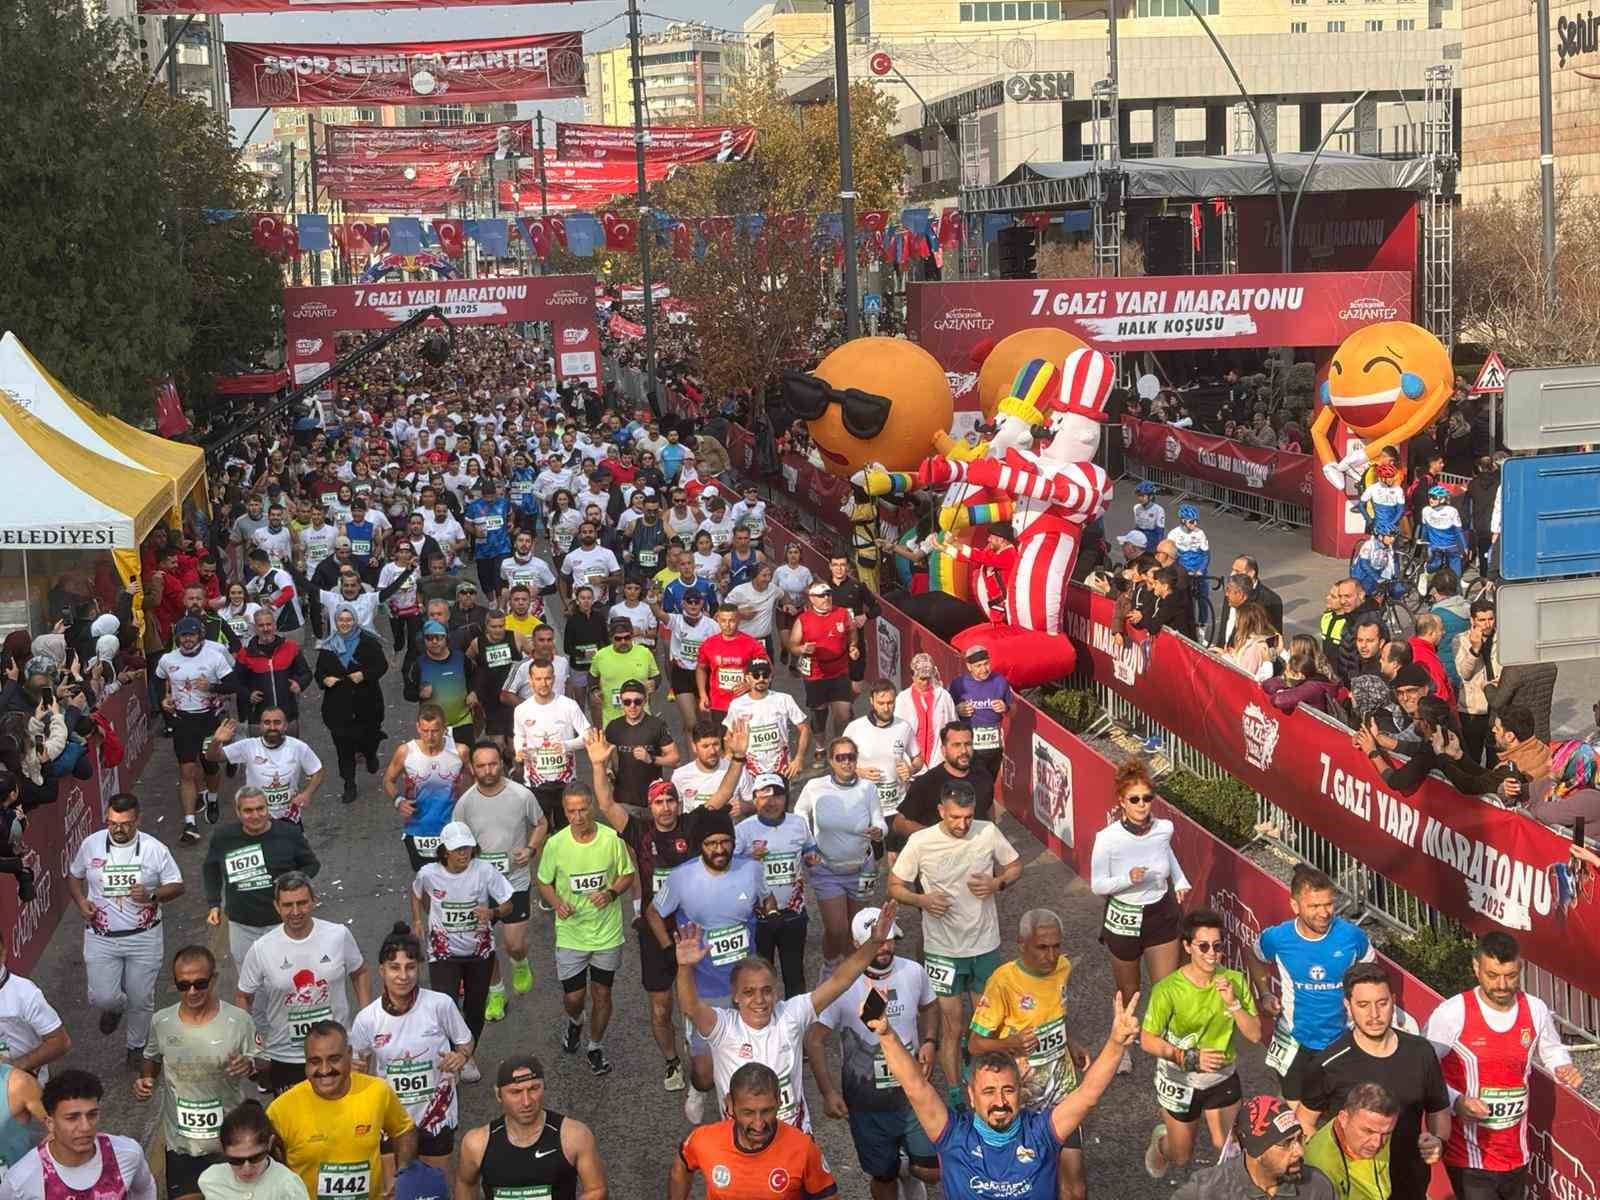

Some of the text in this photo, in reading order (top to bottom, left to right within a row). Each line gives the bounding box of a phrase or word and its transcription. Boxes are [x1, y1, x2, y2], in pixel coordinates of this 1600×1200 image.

[264, 55, 331, 75] SPOR
[408, 289, 440, 305] YARI
[445, 285, 527, 303] MARATONU
[1115, 290, 1167, 314] YARI
[1173, 287, 1304, 313] MARATONU
[455, 304, 478, 314] 2025
[1118, 317, 1224, 336] HALK KOŞUSU
[0, 526, 116, 544] ELEDİYESİ
[753, 731, 777, 744] 1600
[541, 756, 563, 766] 1190
[268, 792, 289, 803] 099
[1376, 790, 1421, 848] YARI
[1422, 817, 1550, 916] MARATONU
[230, 854, 260, 871] 1670
[767, 863, 795, 875] 1034
[108, 874, 137, 886] 1336
[575, 875, 603, 889] 1467
[446, 910, 474, 923] 1754
[1110, 909, 1137, 925] 1263
[714, 934, 744, 953] 1967
[1295, 981, 1343, 991] TEMSA
[393, 1074, 428, 1091] 1961
[181, 1111, 217, 1127] 1530
[324, 1175, 366, 1193] 1442
